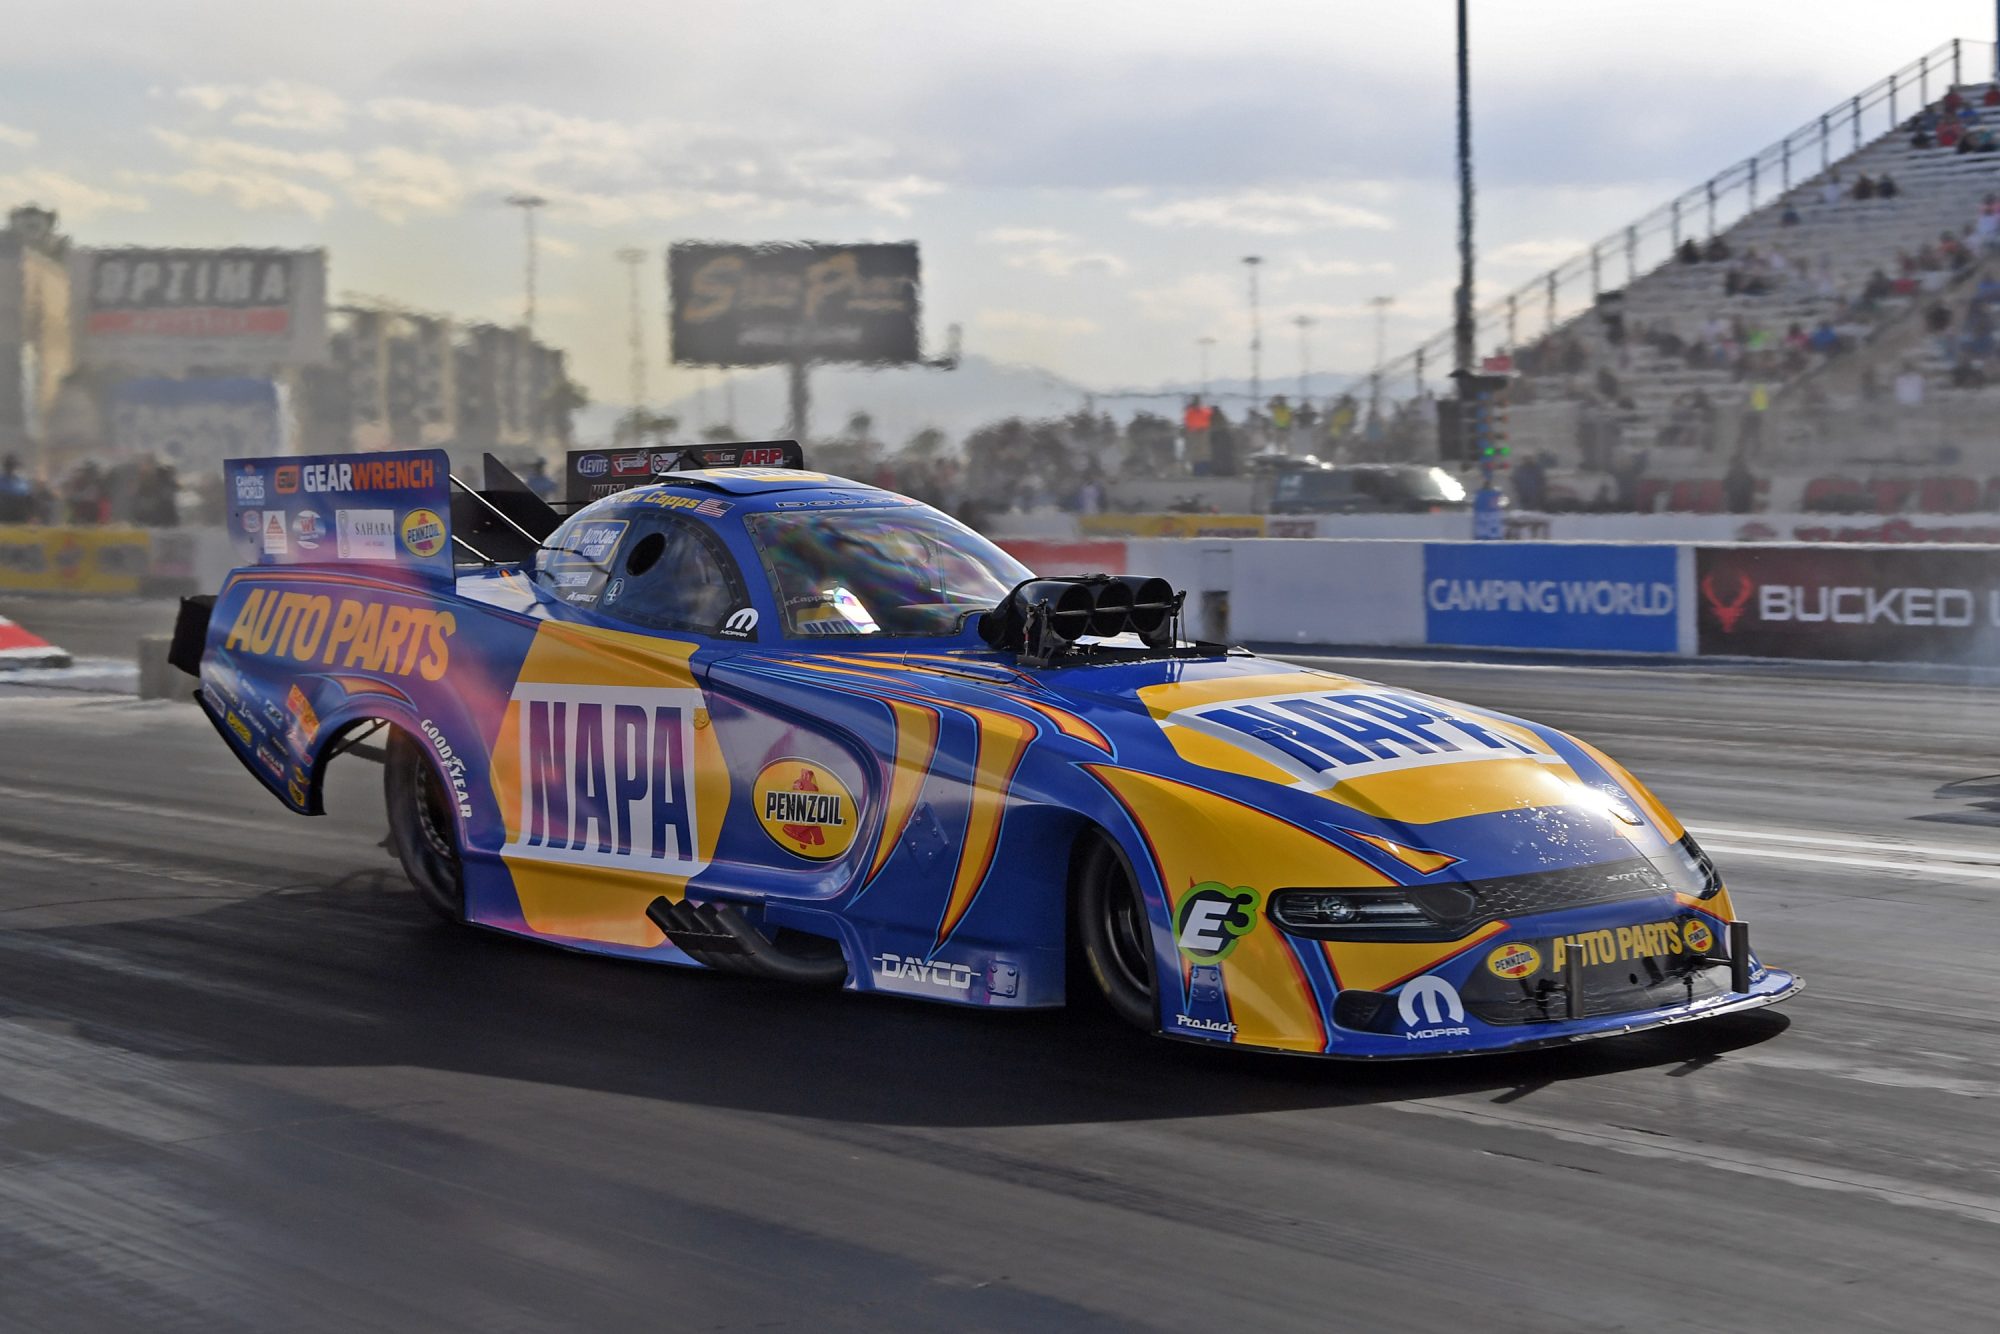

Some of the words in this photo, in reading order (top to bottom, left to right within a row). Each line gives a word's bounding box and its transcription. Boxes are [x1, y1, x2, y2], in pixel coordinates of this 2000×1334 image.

[97, 261, 287, 302] OPTIMA
[577, 455, 609, 474] CLEVITE
[741, 448, 784, 466] ARP
[644, 488, 701, 509] Capps
[406, 523, 441, 543] PENNZOIL
[1428, 578, 1559, 614] CAMPING
[1560, 580, 1675, 616] WORLD
[1759, 584, 1975, 627] BUCKED
[225, 588, 332, 662] AUTO
[322, 598, 457, 682] PARTS
[1195, 693, 1538, 774] NAPA
[420, 719, 473, 818] GOODYEAR
[527, 700, 693, 863] NAPA
[765, 791, 843, 826] PENNZOIL
[1616, 921, 1684, 961] PARTS
[876, 952, 977, 990] DAYCO
[1494, 950, 1535, 972] PENNZOIL
[1405, 1027, 1472, 1040] MOPAR
